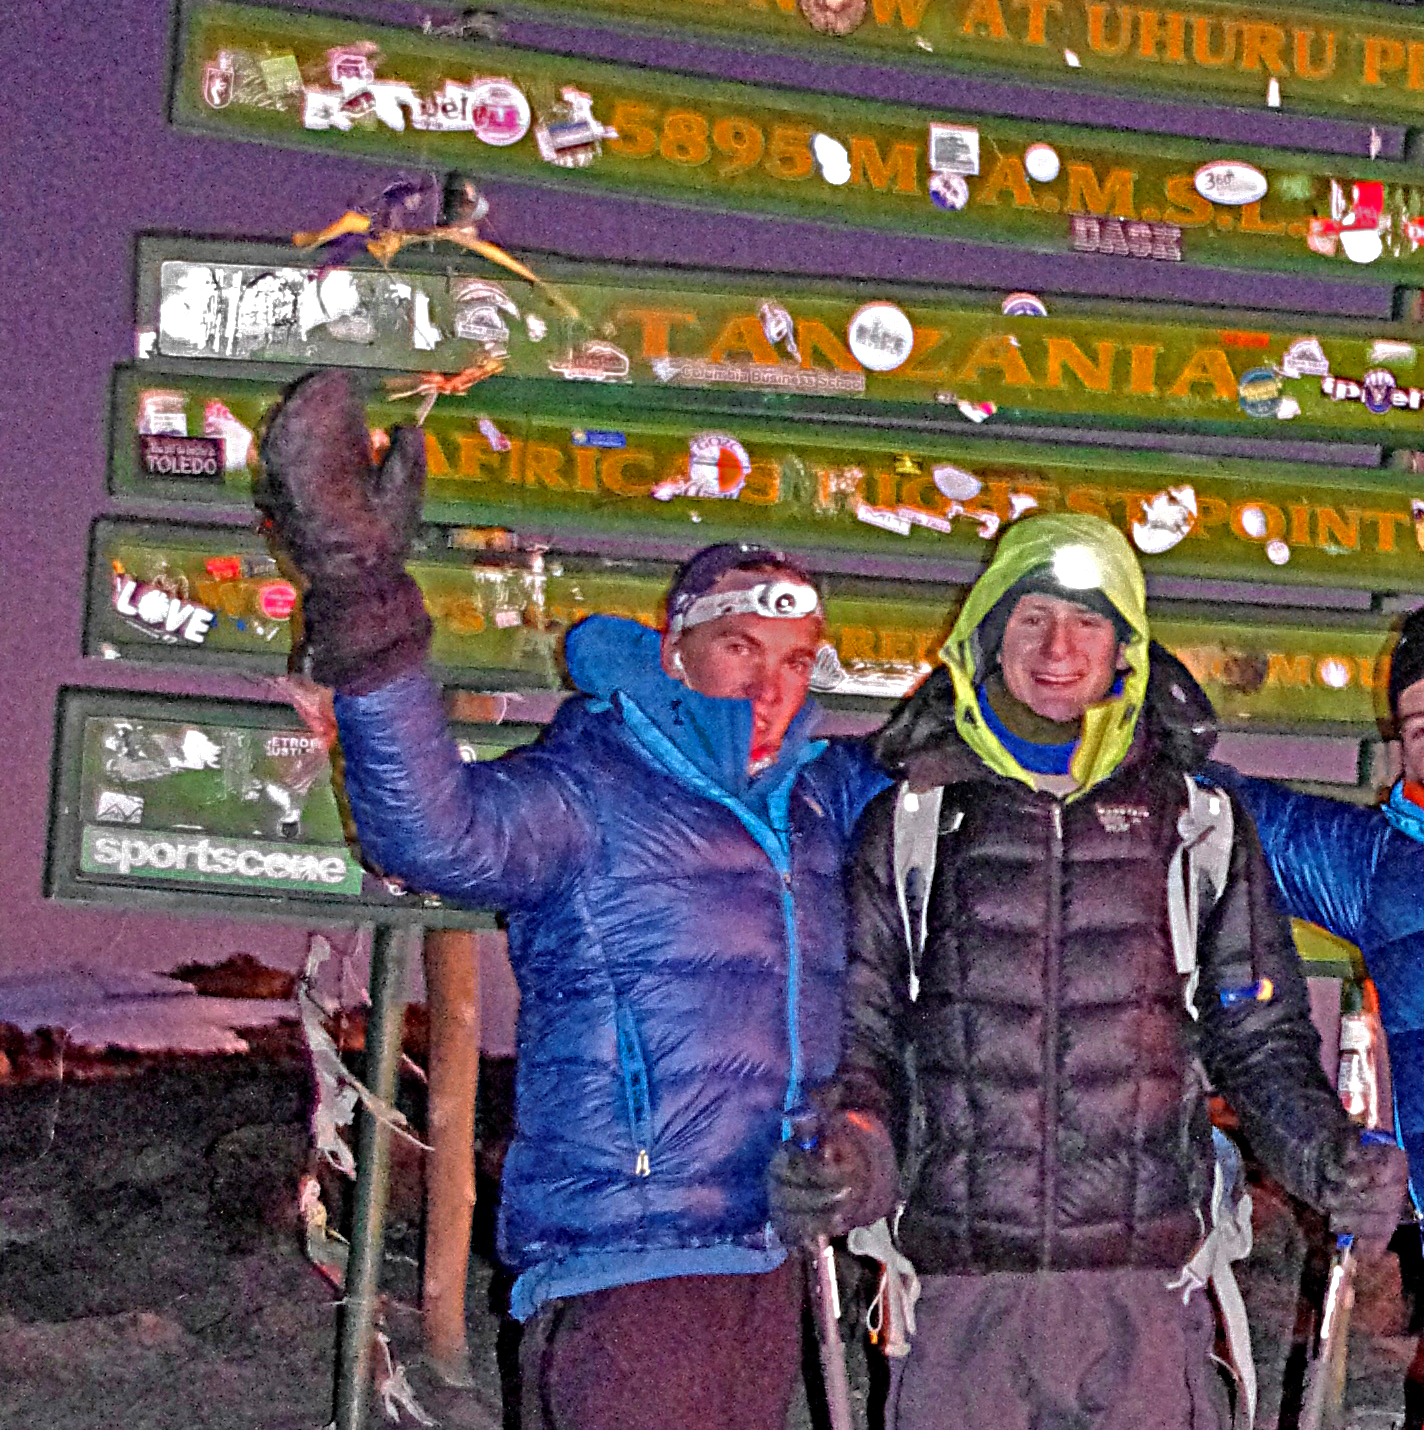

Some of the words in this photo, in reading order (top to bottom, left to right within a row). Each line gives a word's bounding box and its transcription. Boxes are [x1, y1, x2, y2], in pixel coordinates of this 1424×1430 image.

[1084, 1, 1337, 80] UHURU
[616, 306, 1239, 400] TANZANIA
[681, 365, 749, 383] Columbia
[751, 370, 815, 386] Business
[817, 375, 865, 392] School
[146, 455, 218, 476] TOLEDO
[94, 836, 347, 885] sportscene
